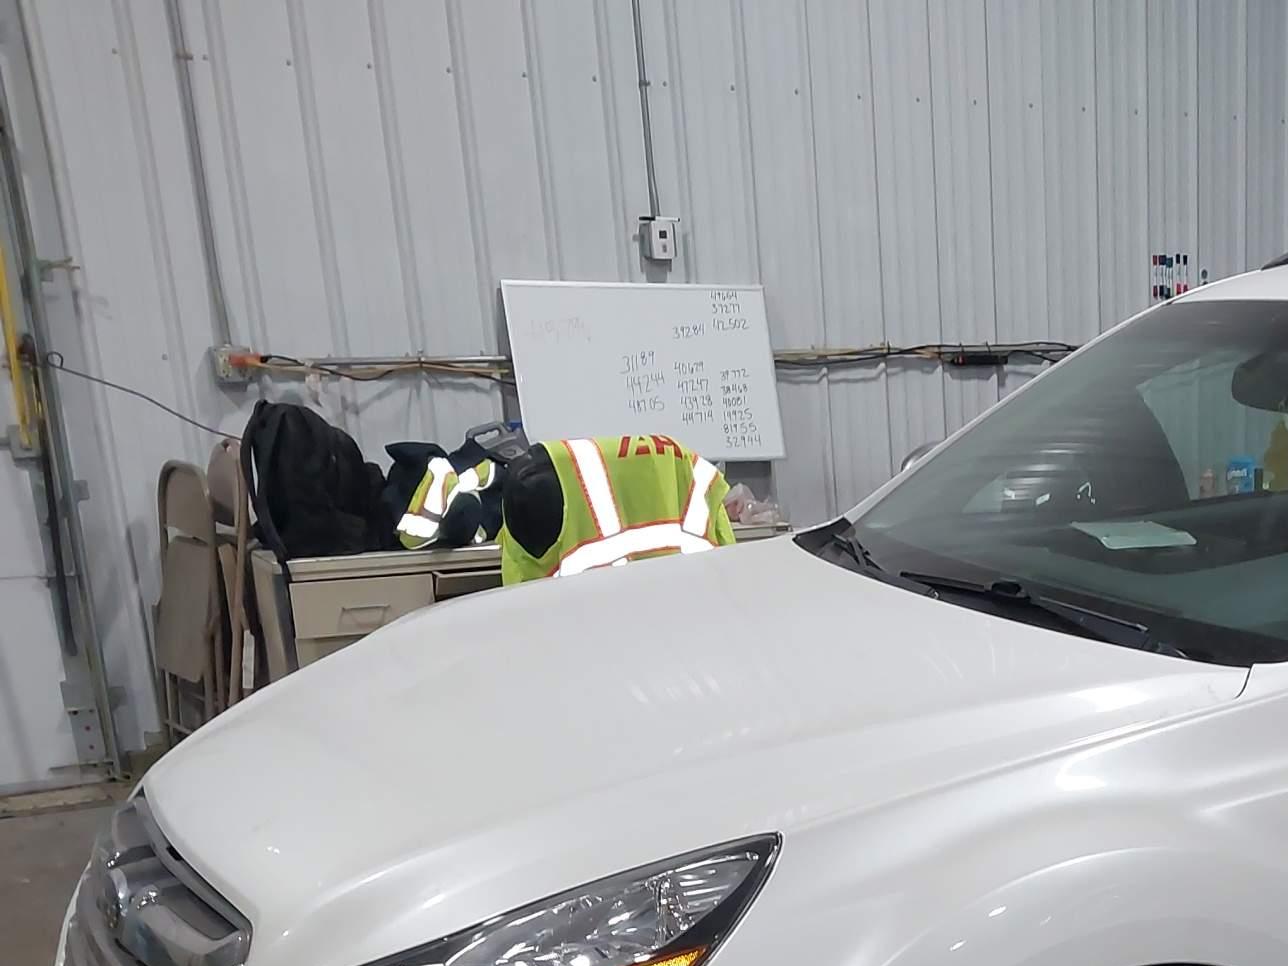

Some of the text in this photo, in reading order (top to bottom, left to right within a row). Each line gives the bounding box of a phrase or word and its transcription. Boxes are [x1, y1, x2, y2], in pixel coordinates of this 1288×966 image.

[672, 322, 705, 339] 39284
[619, 351, 655, 374] 31189
[626, 370, 665, 398] 44244
[678, 377, 709, 394] 47247
[680, 394, 713, 410] 43928
[682, 409, 714, 425] 44714
[726, 434, 762, 449] 32944
